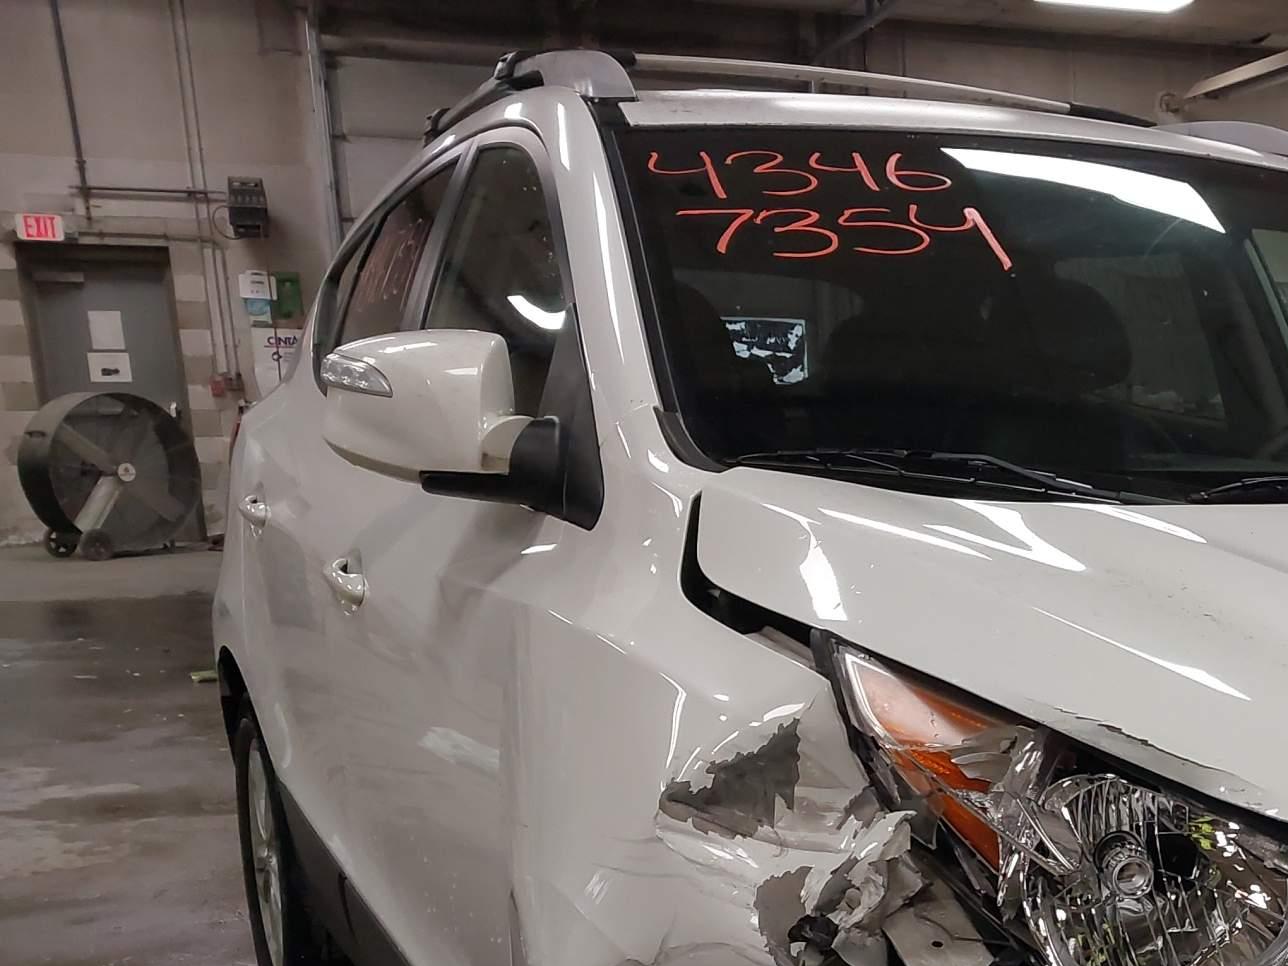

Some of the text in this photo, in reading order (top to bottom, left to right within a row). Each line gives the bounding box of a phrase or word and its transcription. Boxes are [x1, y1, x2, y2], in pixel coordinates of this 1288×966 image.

[648, 150, 952, 199] 4346
[23, 214, 56, 239] EXIT
[675, 203, 1013, 271] 7354
[267, 335, 298, 346] CINTA
